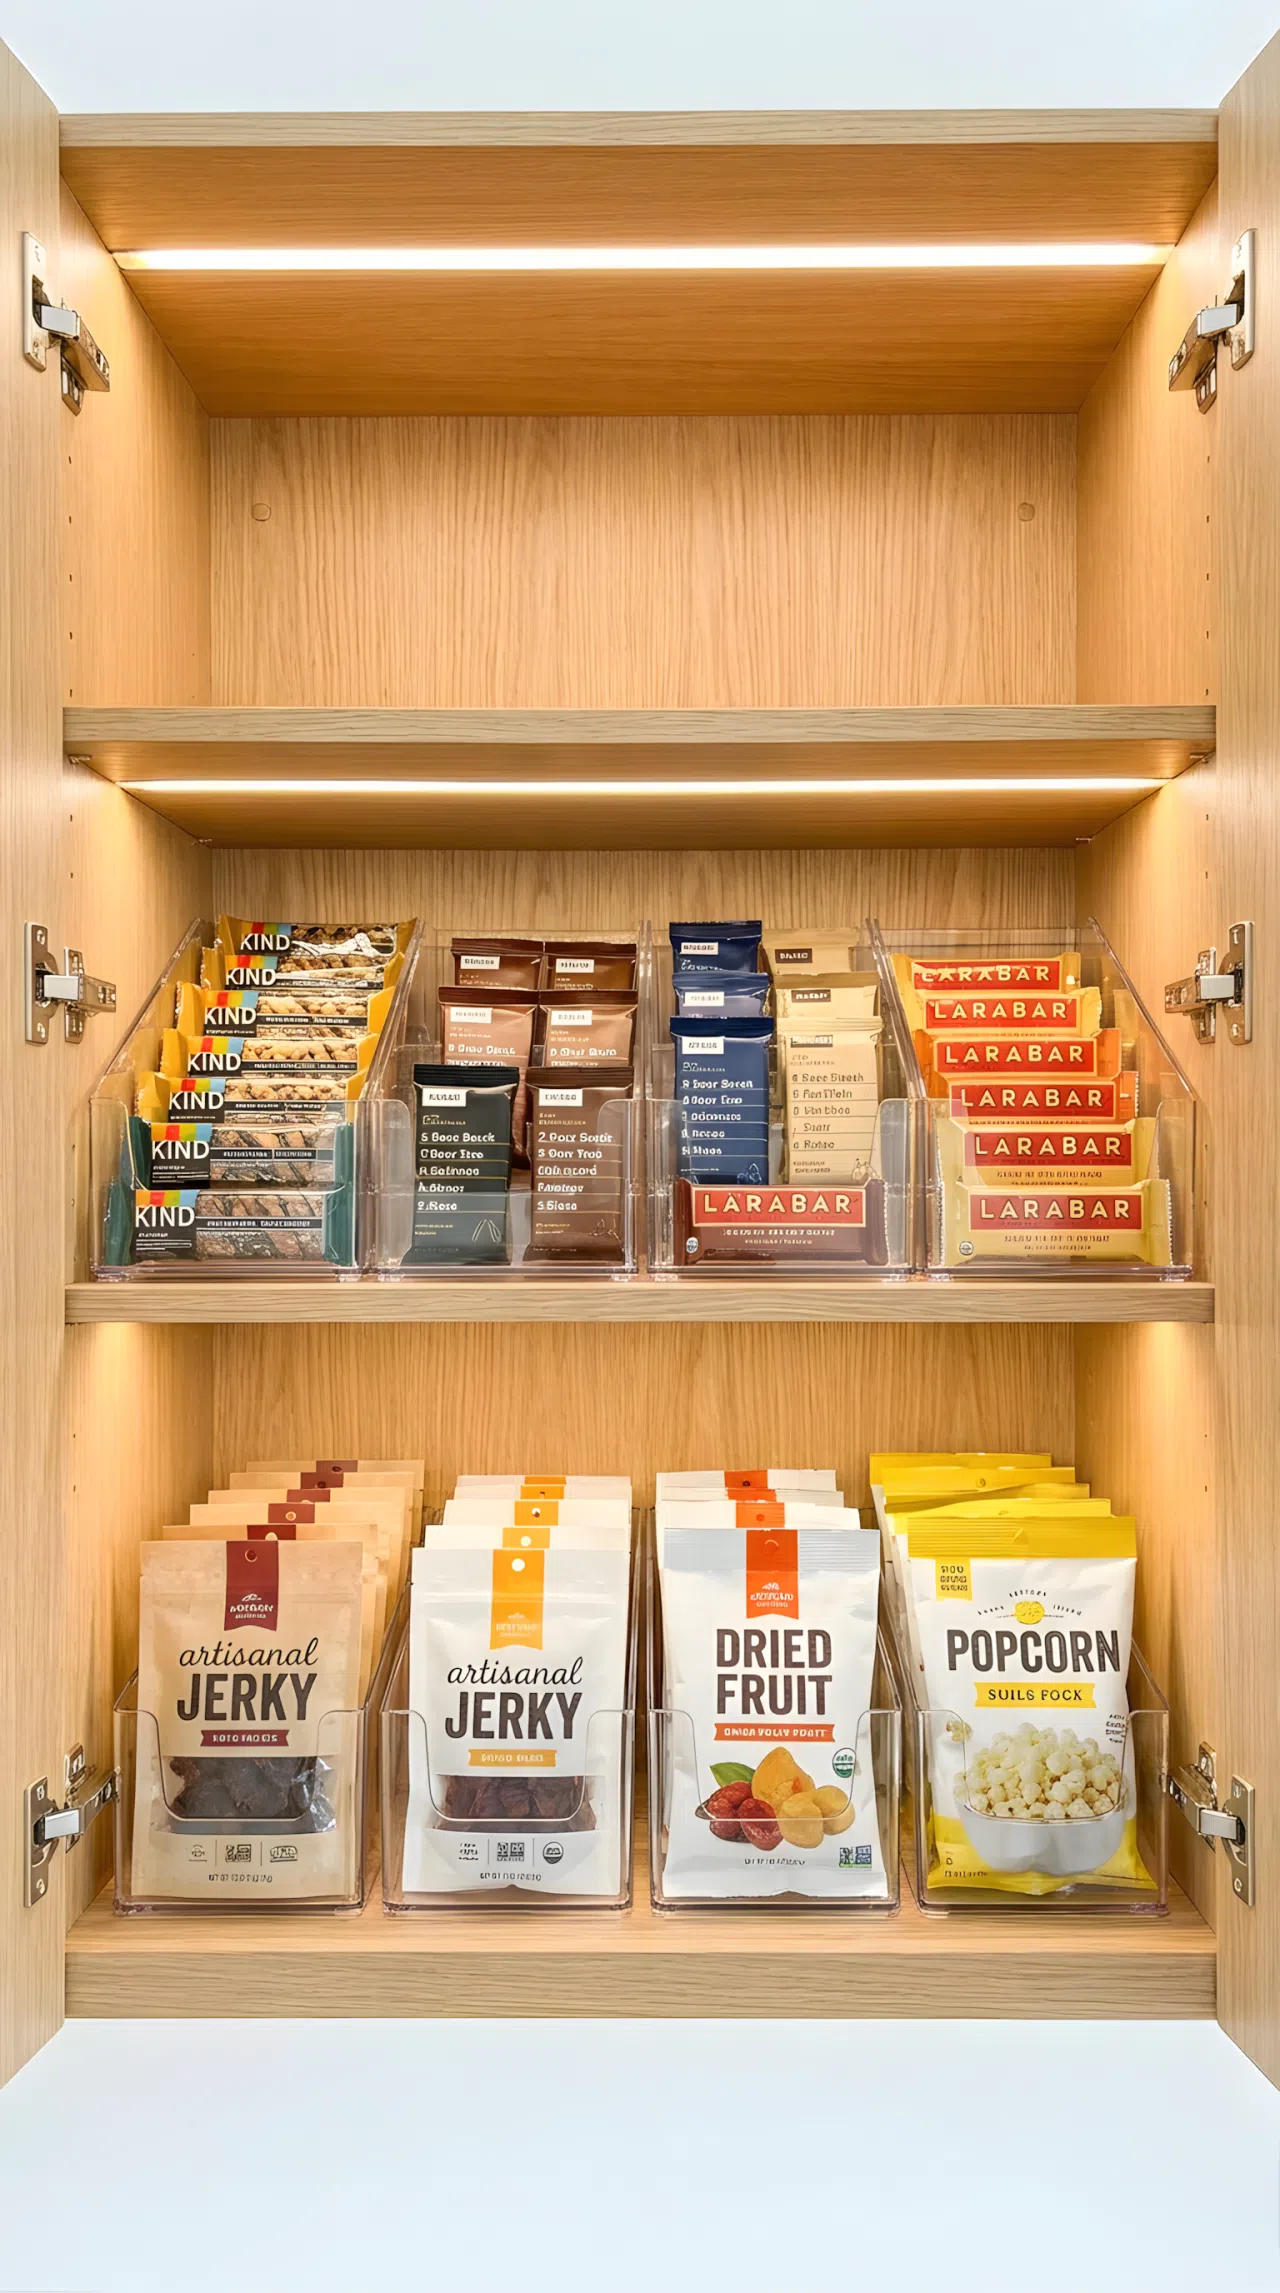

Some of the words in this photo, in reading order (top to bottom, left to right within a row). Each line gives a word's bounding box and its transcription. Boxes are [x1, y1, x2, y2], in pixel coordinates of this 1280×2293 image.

[240, 933, 291, 951] KIND
[225, 967, 277, 987] KIND
[204, 1006, 257, 1026] KIND
[934, 1001, 1067, 1019] LARABAR
[188, 1052, 242, 1072] KIND
[945, 1044, 1083, 1064] LARABAR
[169, 1091, 224, 1110] KIND
[960, 1088, 1103, 1107] LARABAR
[152, 1140, 211, 1160] KIND
[975, 1135, 1122, 1156] LARABAR
[704, 1193, 852, 1214] LARABAR
[980, 1198, 1131, 1220] LARABAR
[136, 1206, 196, 1228] KIND
[179, 1637, 319, 1667] artisanal
[716, 1628, 833, 1669] DRIED
[946, 1629, 1121, 1673] POPCORN
[447, 1656, 584, 1685] artisanal
[176, 1673, 318, 1721] JERKY
[716, 1673, 833, 1716] FRUIT
[445, 1691, 583, 1740] JERKY
